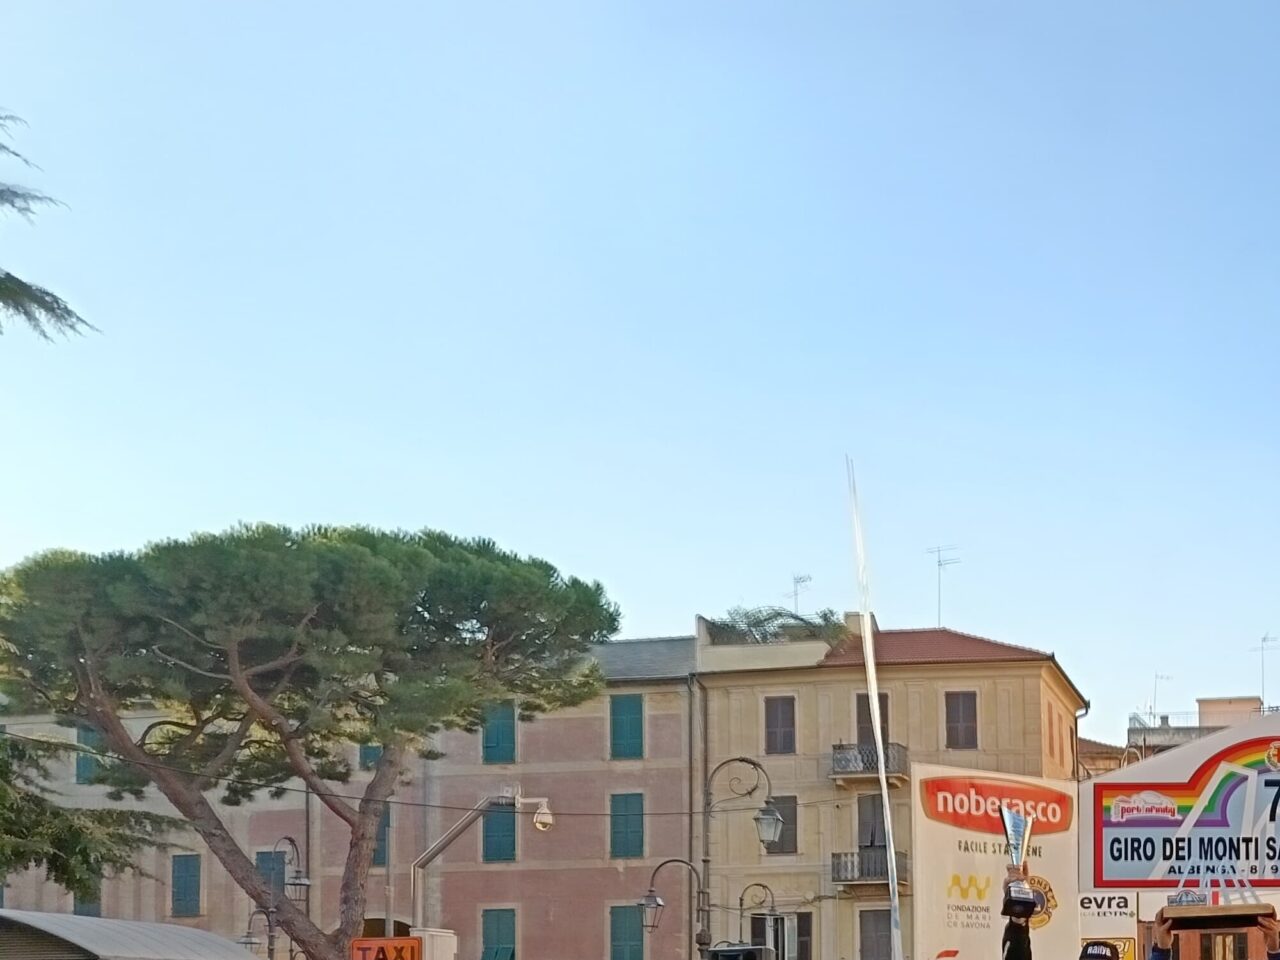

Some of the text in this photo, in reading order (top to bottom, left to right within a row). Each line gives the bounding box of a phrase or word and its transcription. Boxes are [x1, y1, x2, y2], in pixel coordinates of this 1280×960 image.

[957, 840, 988, 854] FACILE
[991, 842, 1018, 857] STA
[1109, 836, 1156, 862] GIRO
[1162, 836, 1192, 862] DEI
[1198, 836, 1259, 861] MONTI
[1167, 864, 1279, 875] ALBENGA 8 9
[946, 903, 991, 914] FONDAZIONE
[960, 920, 991, 930] SAVONA
